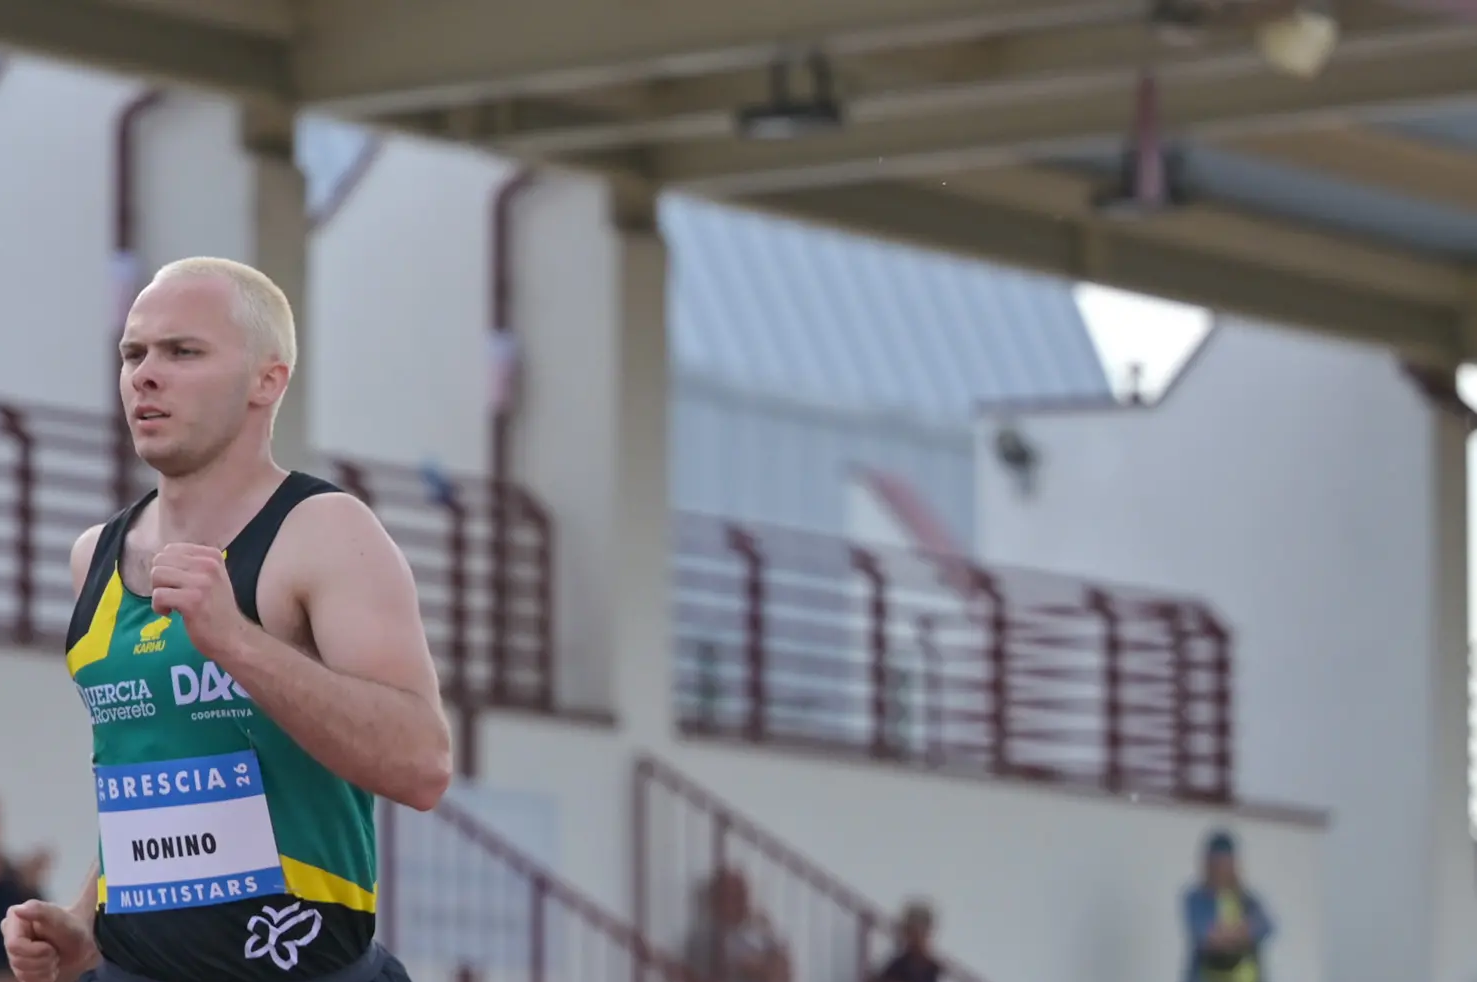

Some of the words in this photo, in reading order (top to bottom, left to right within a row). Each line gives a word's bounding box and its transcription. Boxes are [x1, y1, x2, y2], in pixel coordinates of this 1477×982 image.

[133, 640, 166, 655] KARHU
[93, 700, 156, 724] Rovereto
[191, 708, 253, 720] COOPERATIVA
[107, 767, 227, 800] BRESCIA
[233, 762, 252, 788] 26
[131, 832, 218, 862] NONINO
[121, 876, 259, 908] MULTISTARS
